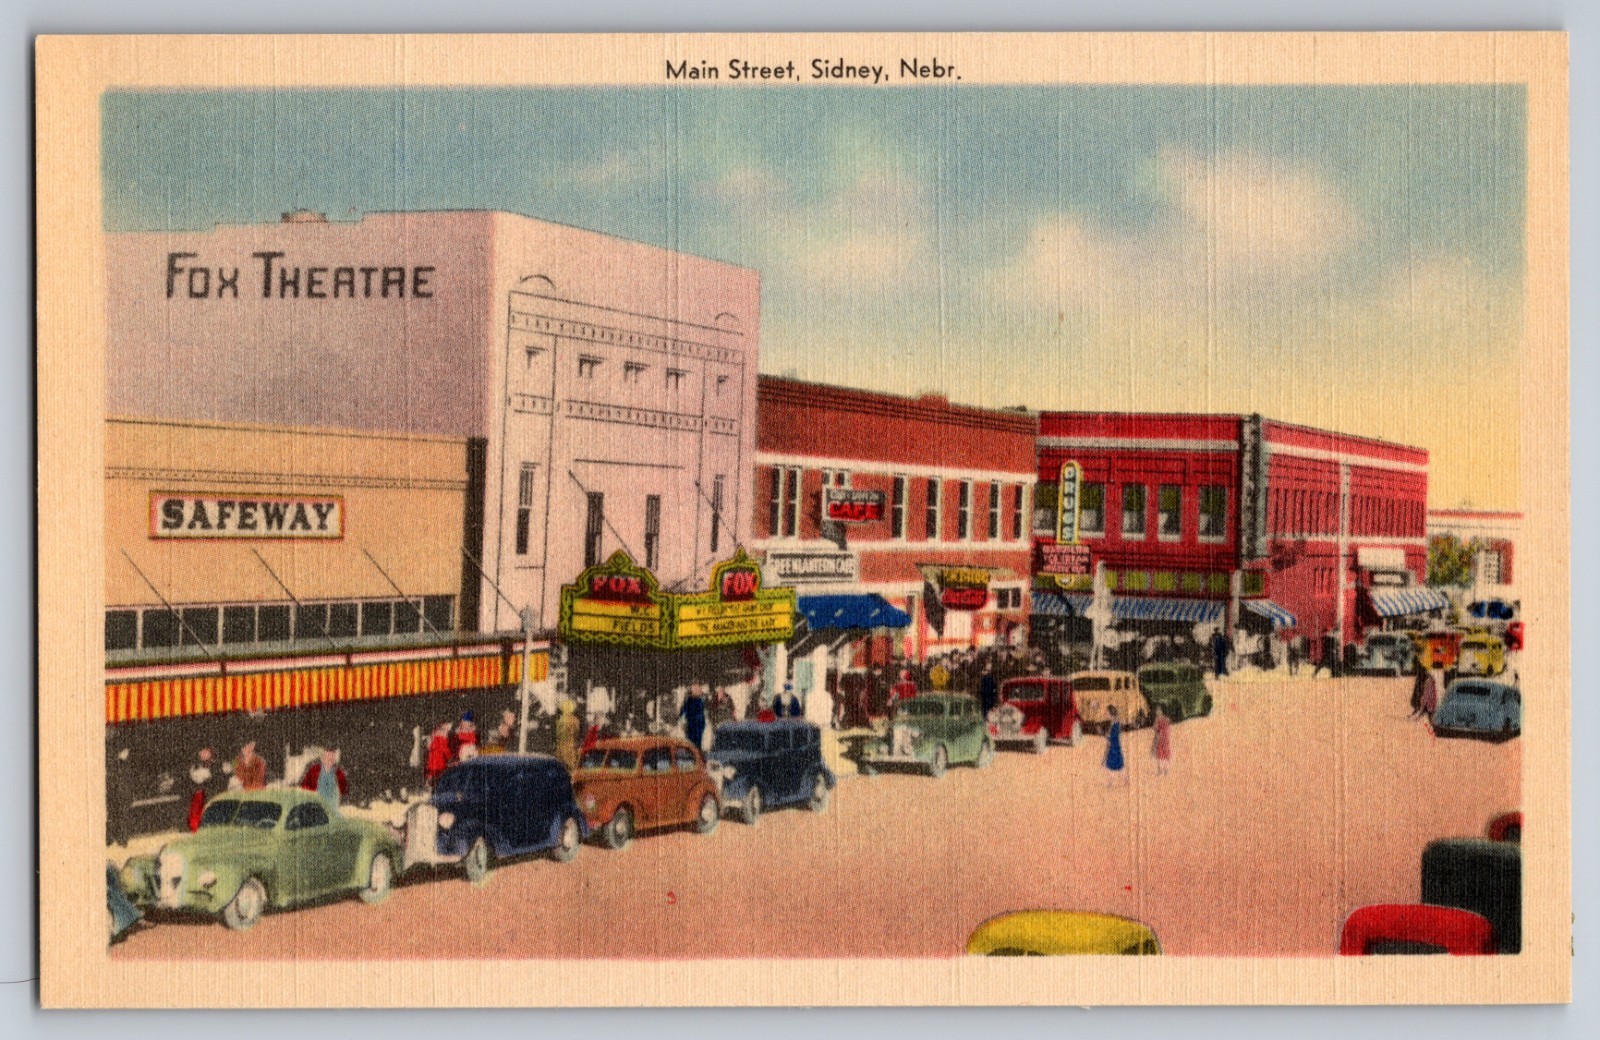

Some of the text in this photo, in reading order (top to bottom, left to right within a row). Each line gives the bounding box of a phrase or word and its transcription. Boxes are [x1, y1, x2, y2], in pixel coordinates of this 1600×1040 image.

[666, 58, 961, 83] Main Street, Sidney, Nebr.
[166, 252, 436, 299] FOX THEATRE
[161, 499, 335, 531] SAFEWAY
[592, 576, 643, 595] FOX
[722, 571, 759, 596] FOX
